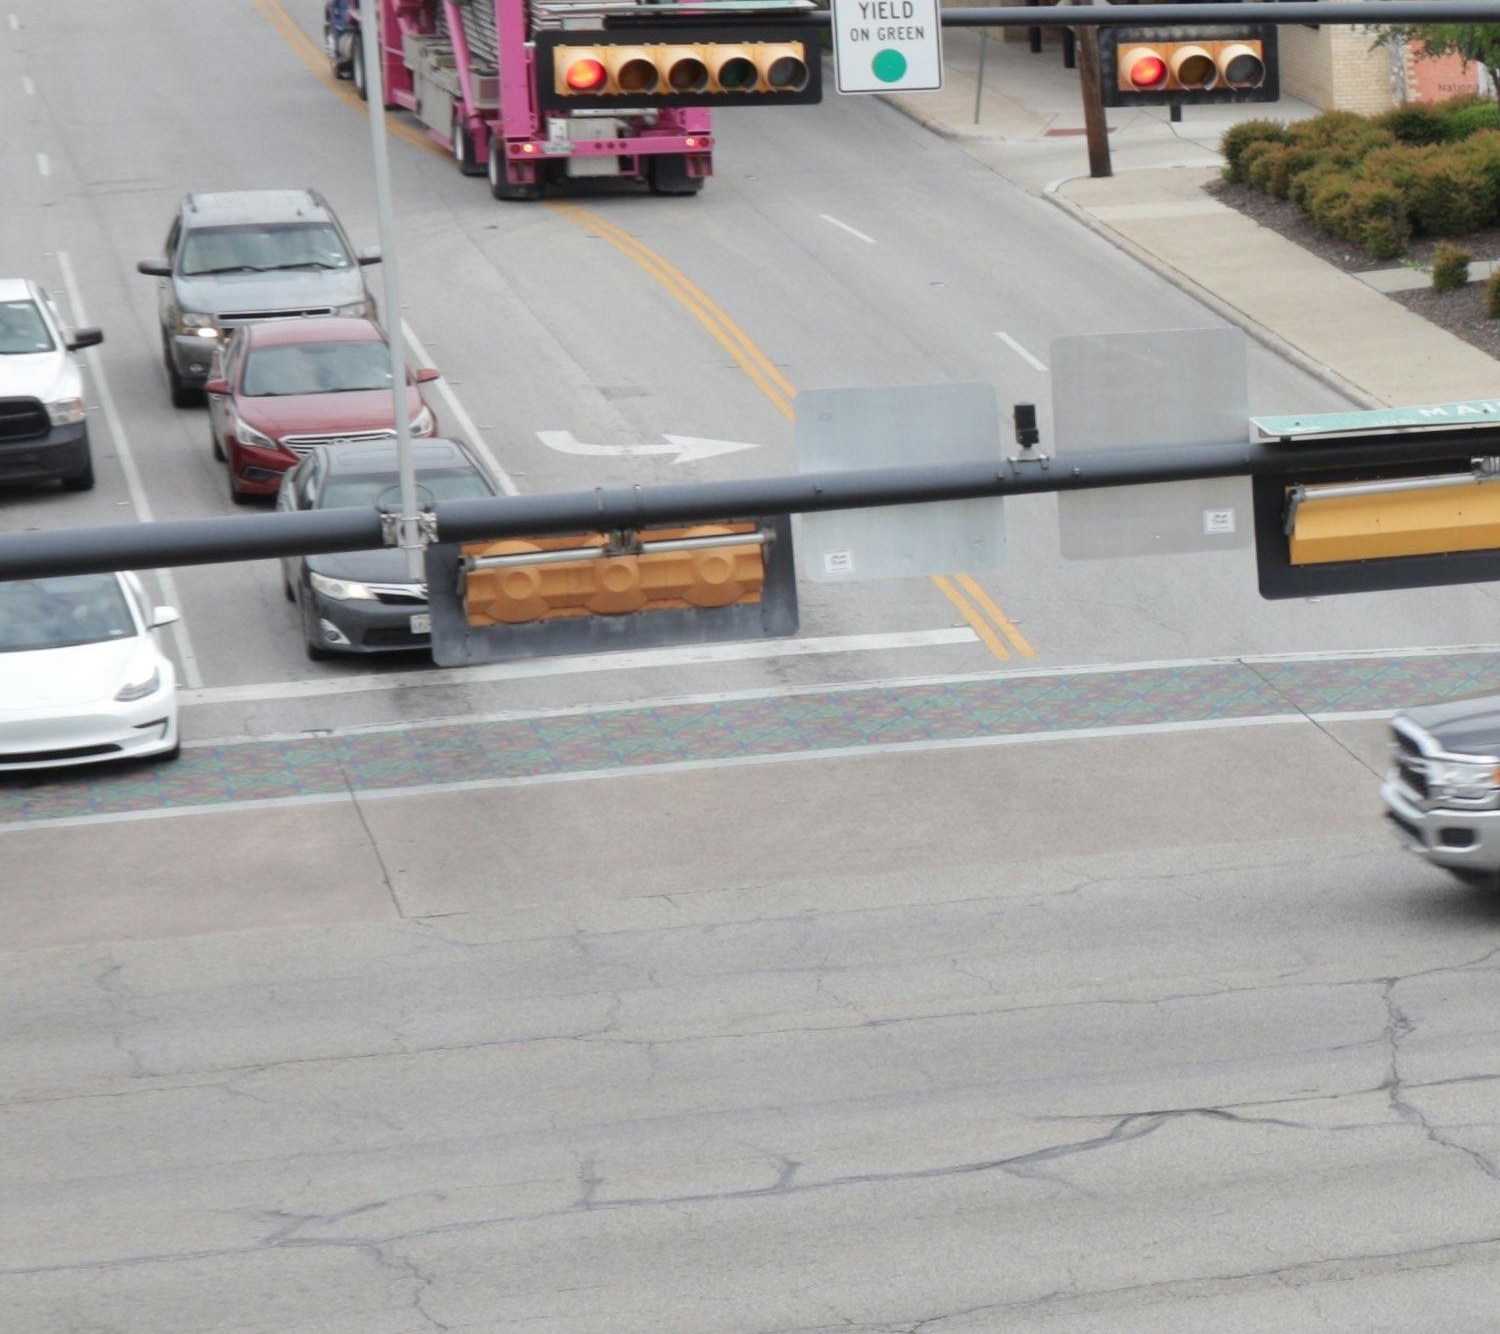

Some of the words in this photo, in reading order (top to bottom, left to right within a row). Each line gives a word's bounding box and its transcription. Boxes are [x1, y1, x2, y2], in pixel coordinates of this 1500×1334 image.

[858, 0, 914, 20] YIELD
[849, 28, 870, 42] ON
[877, 26, 925, 41] GREEN
